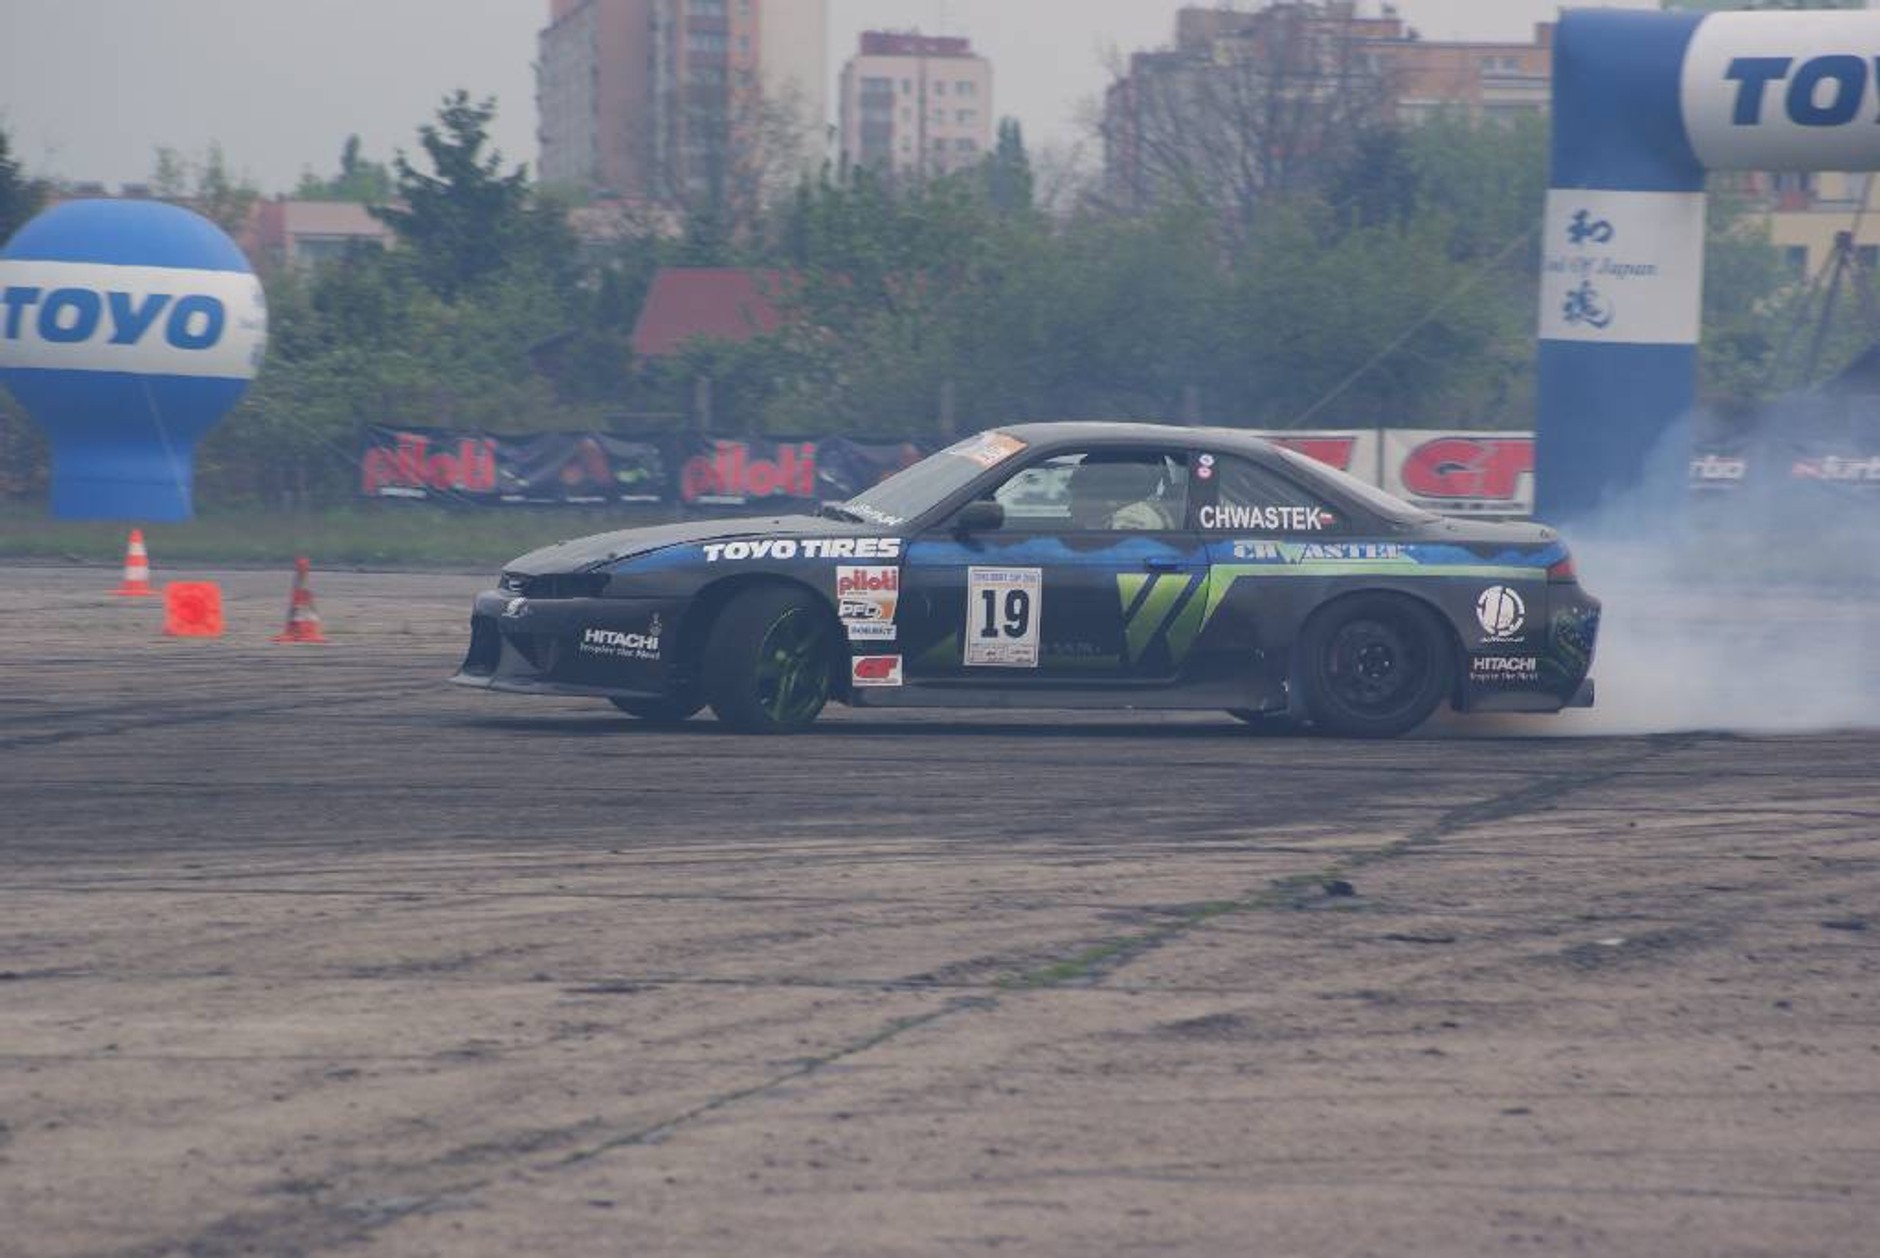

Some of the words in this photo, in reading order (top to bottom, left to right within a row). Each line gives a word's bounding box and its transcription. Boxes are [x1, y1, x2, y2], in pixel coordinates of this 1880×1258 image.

[1724, 54, 1880, 126] TO
[1597, 257, 1657, 280] Japan
[1, 286, 226, 350] TOYO
[361, 434, 497, 496] piloti
[681, 441, 816, 500] piloti
[1200, 506, 1321, 530] CHWASTEK
[703, 540, 796, 562] TOYO
[800, 538, 901, 558] TIRES
[839, 569, 897, 596] piloti
[981, 589, 1030, 639] 19
[585, 629, 659, 650] HITACHI
[1474, 657, 1536, 671] HITACHI
